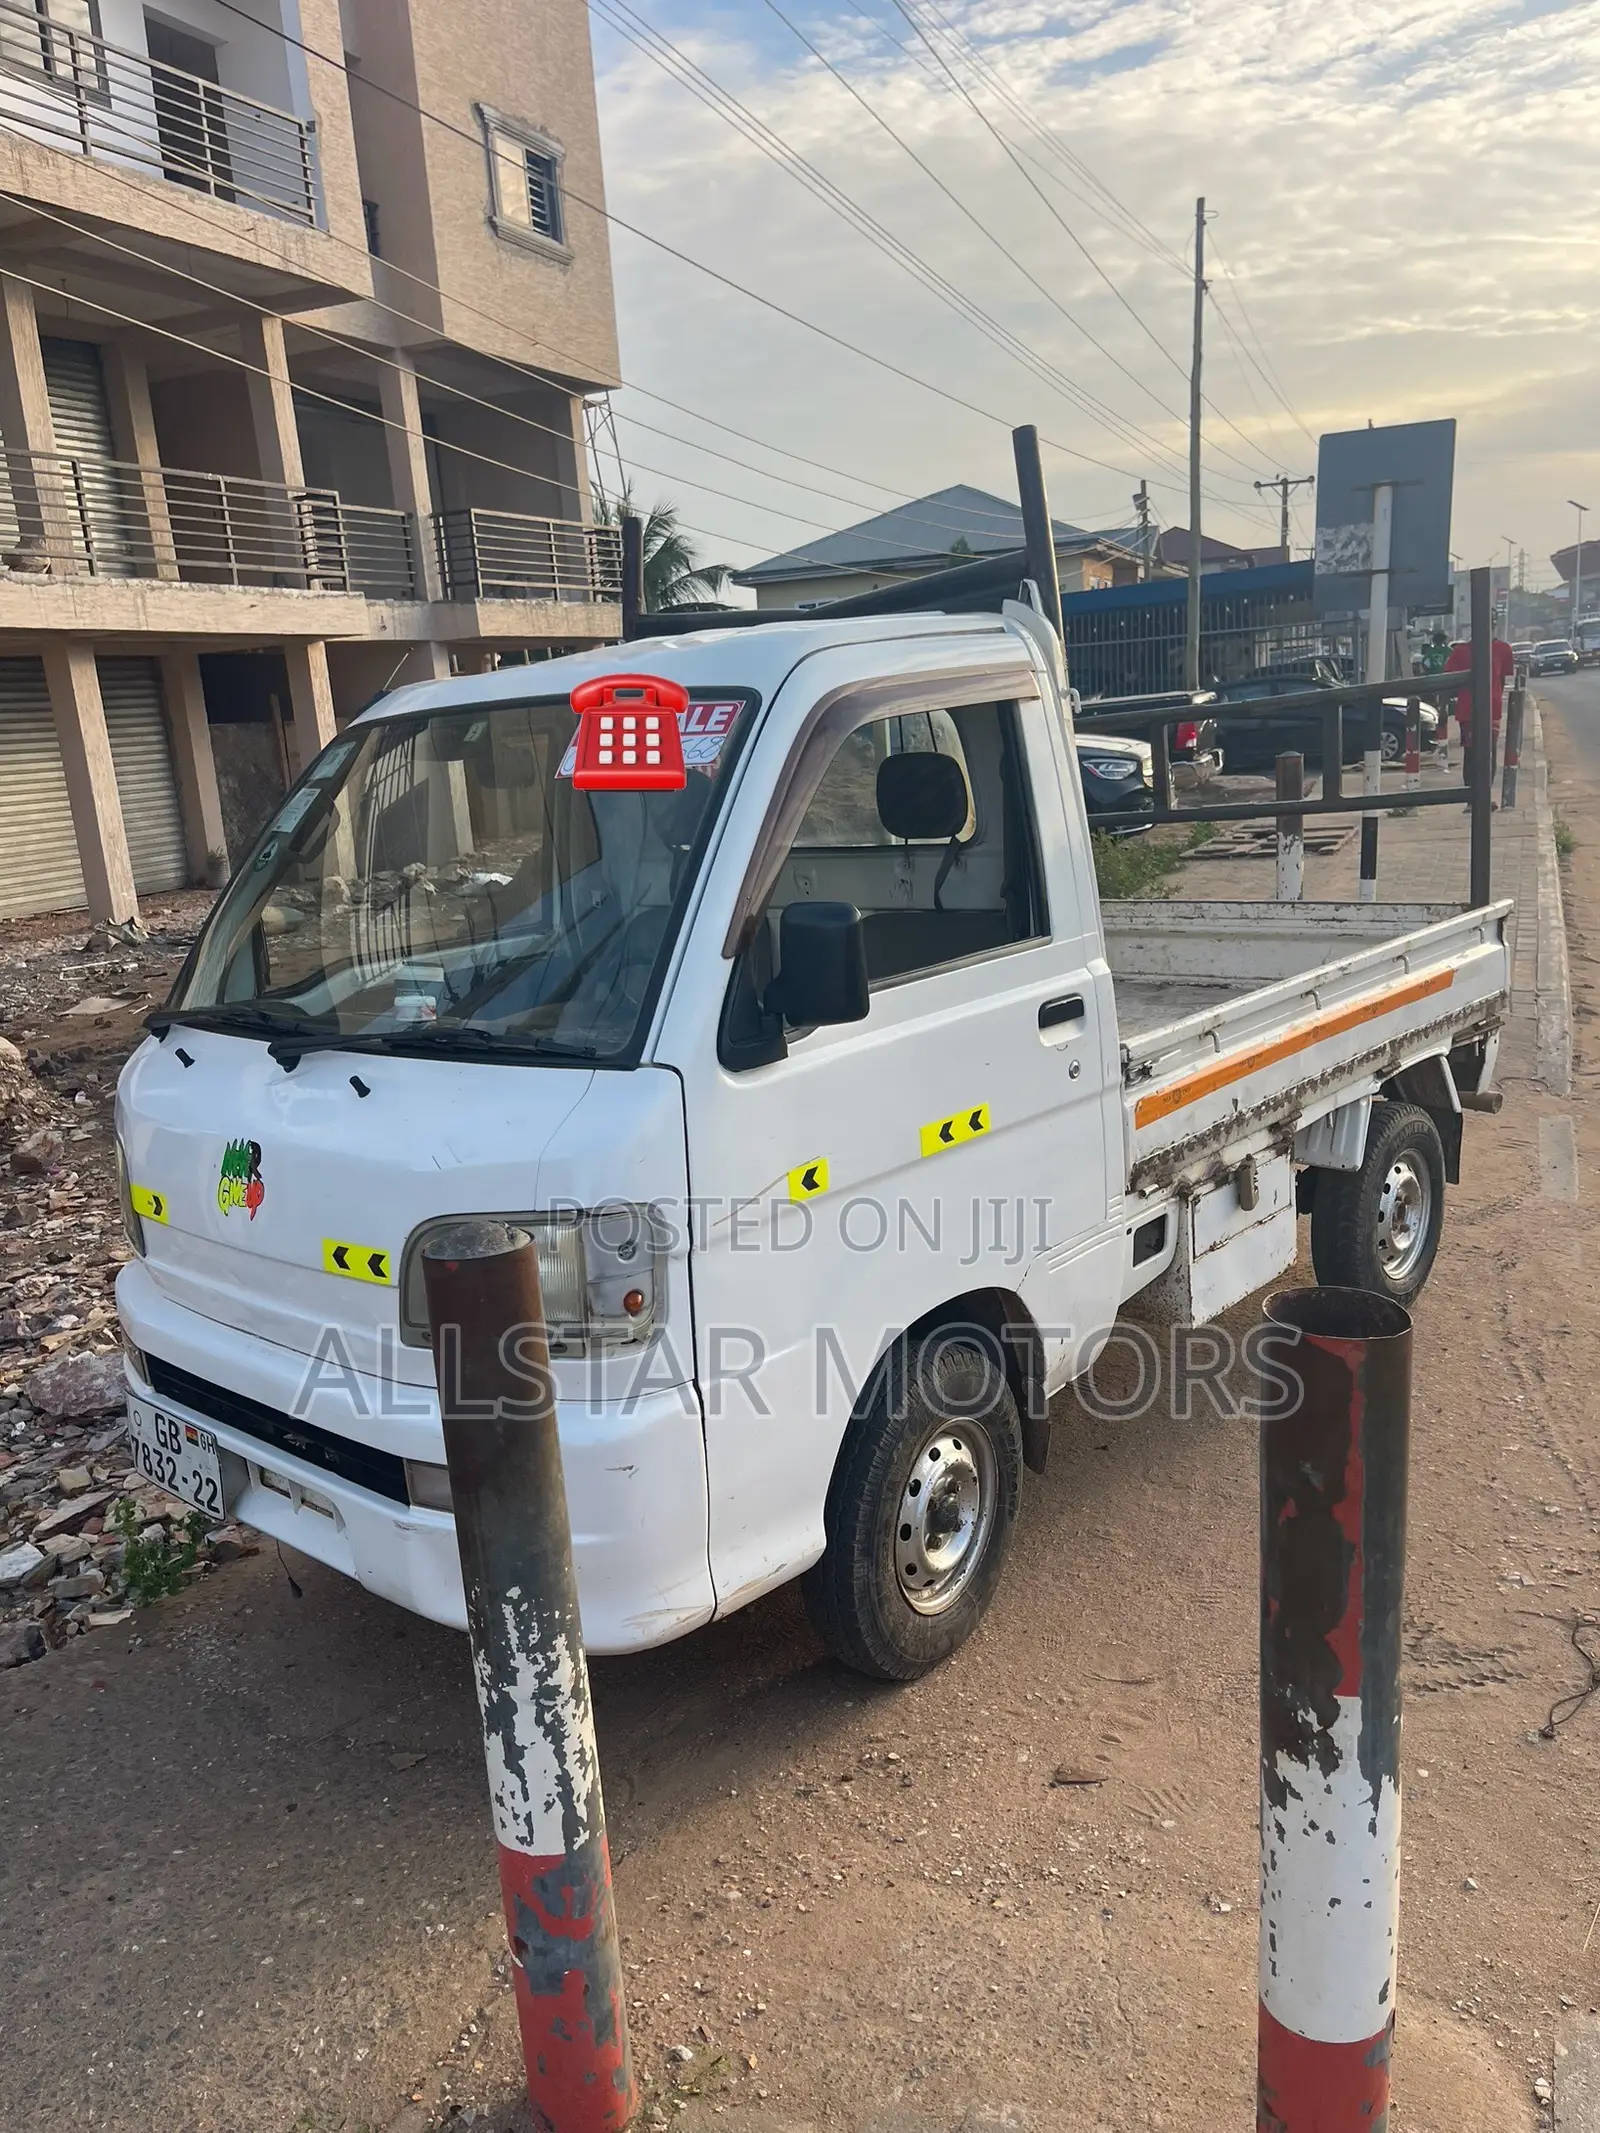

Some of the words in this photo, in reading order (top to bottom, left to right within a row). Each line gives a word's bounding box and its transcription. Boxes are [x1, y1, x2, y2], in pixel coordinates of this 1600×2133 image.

[154, 1412, 183, 1455] GB
[199, 1432, 216, 1455] GH
[130, 1434, 221, 1515] 7832-22
